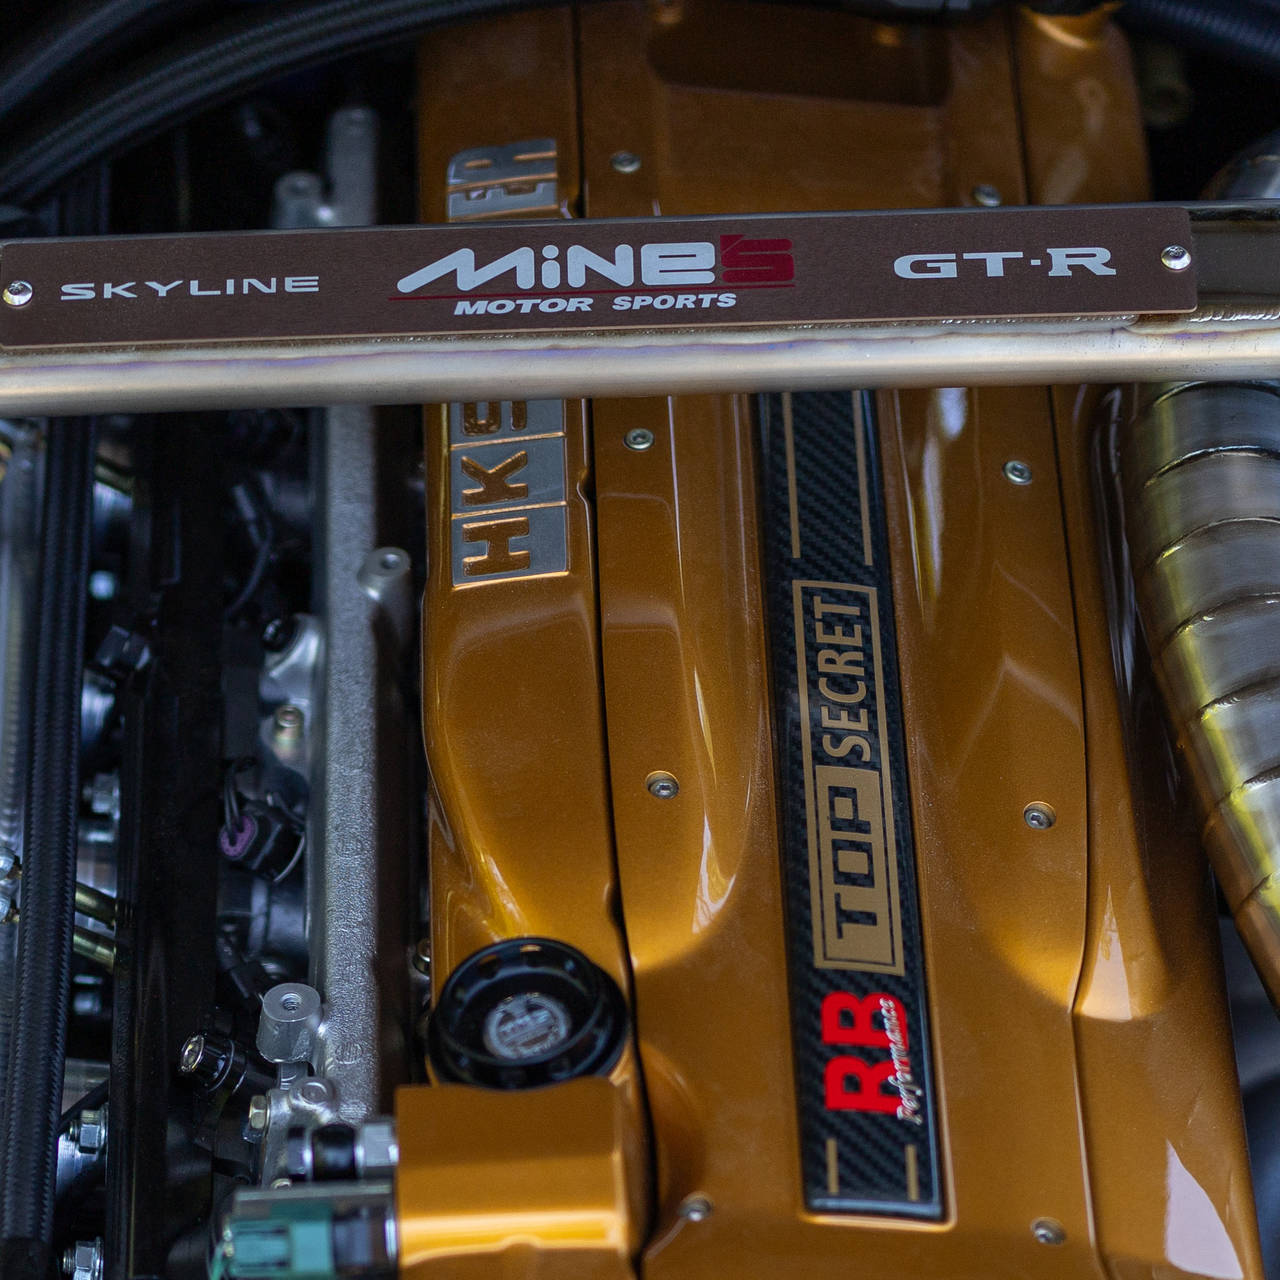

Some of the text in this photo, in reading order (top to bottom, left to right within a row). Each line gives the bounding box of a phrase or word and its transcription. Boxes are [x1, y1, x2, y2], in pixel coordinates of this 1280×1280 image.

[60, 275, 320, 300] SKYLINE
[453, 291, 738, 317] MOTOR SPORTS
[813, 595, 878, 940] TOP SECRET
[820, 990, 910, 1116] RB
